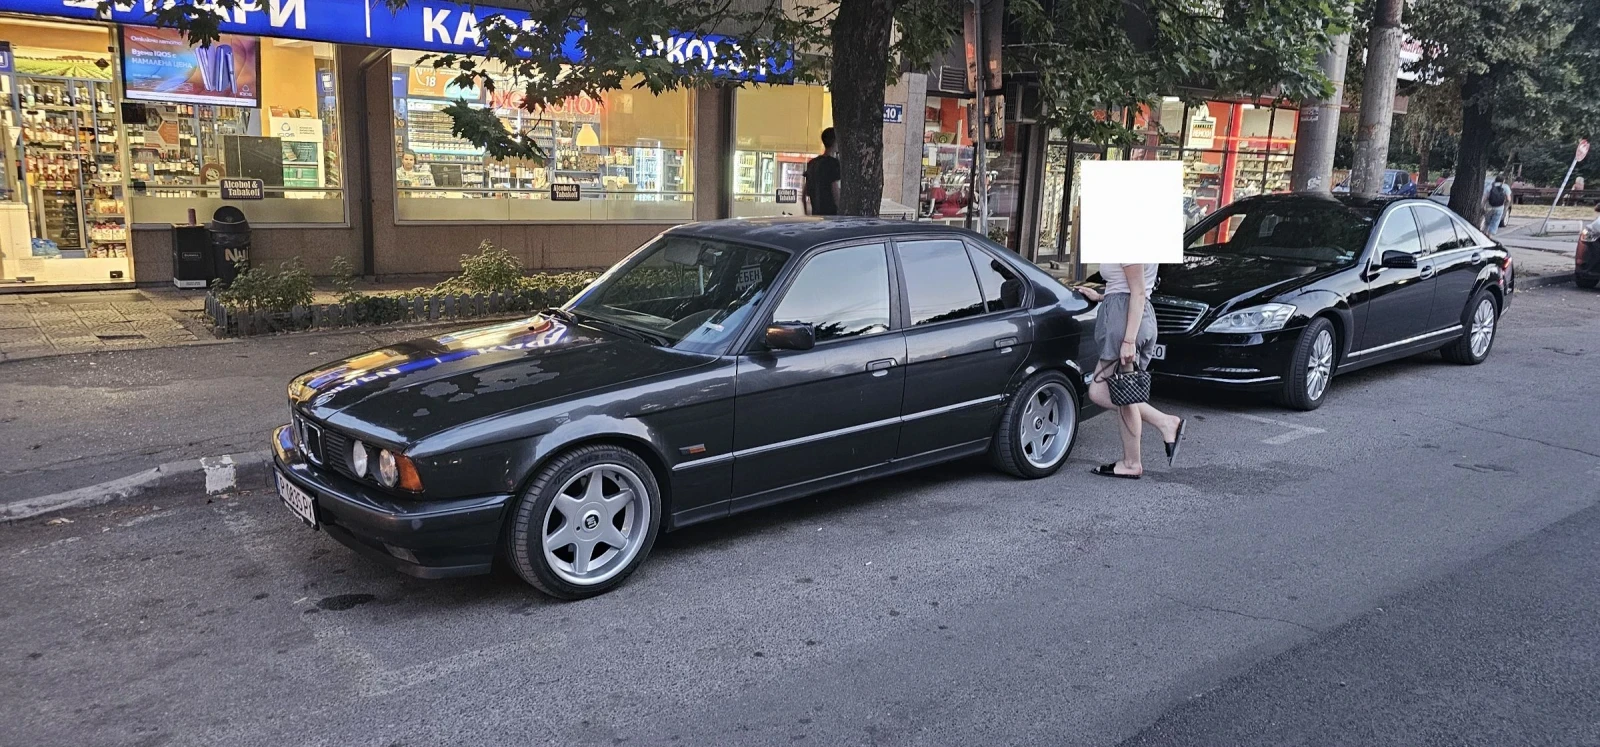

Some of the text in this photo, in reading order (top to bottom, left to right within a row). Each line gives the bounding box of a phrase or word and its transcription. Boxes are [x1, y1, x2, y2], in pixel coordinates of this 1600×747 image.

[153, 50, 172, 58] IQOS
[131, 57, 193, 69] НАМАЛЕНА ЦЕНА
[425, 76, 436, 87] 18
[223, 180, 251, 188] Alcohol
